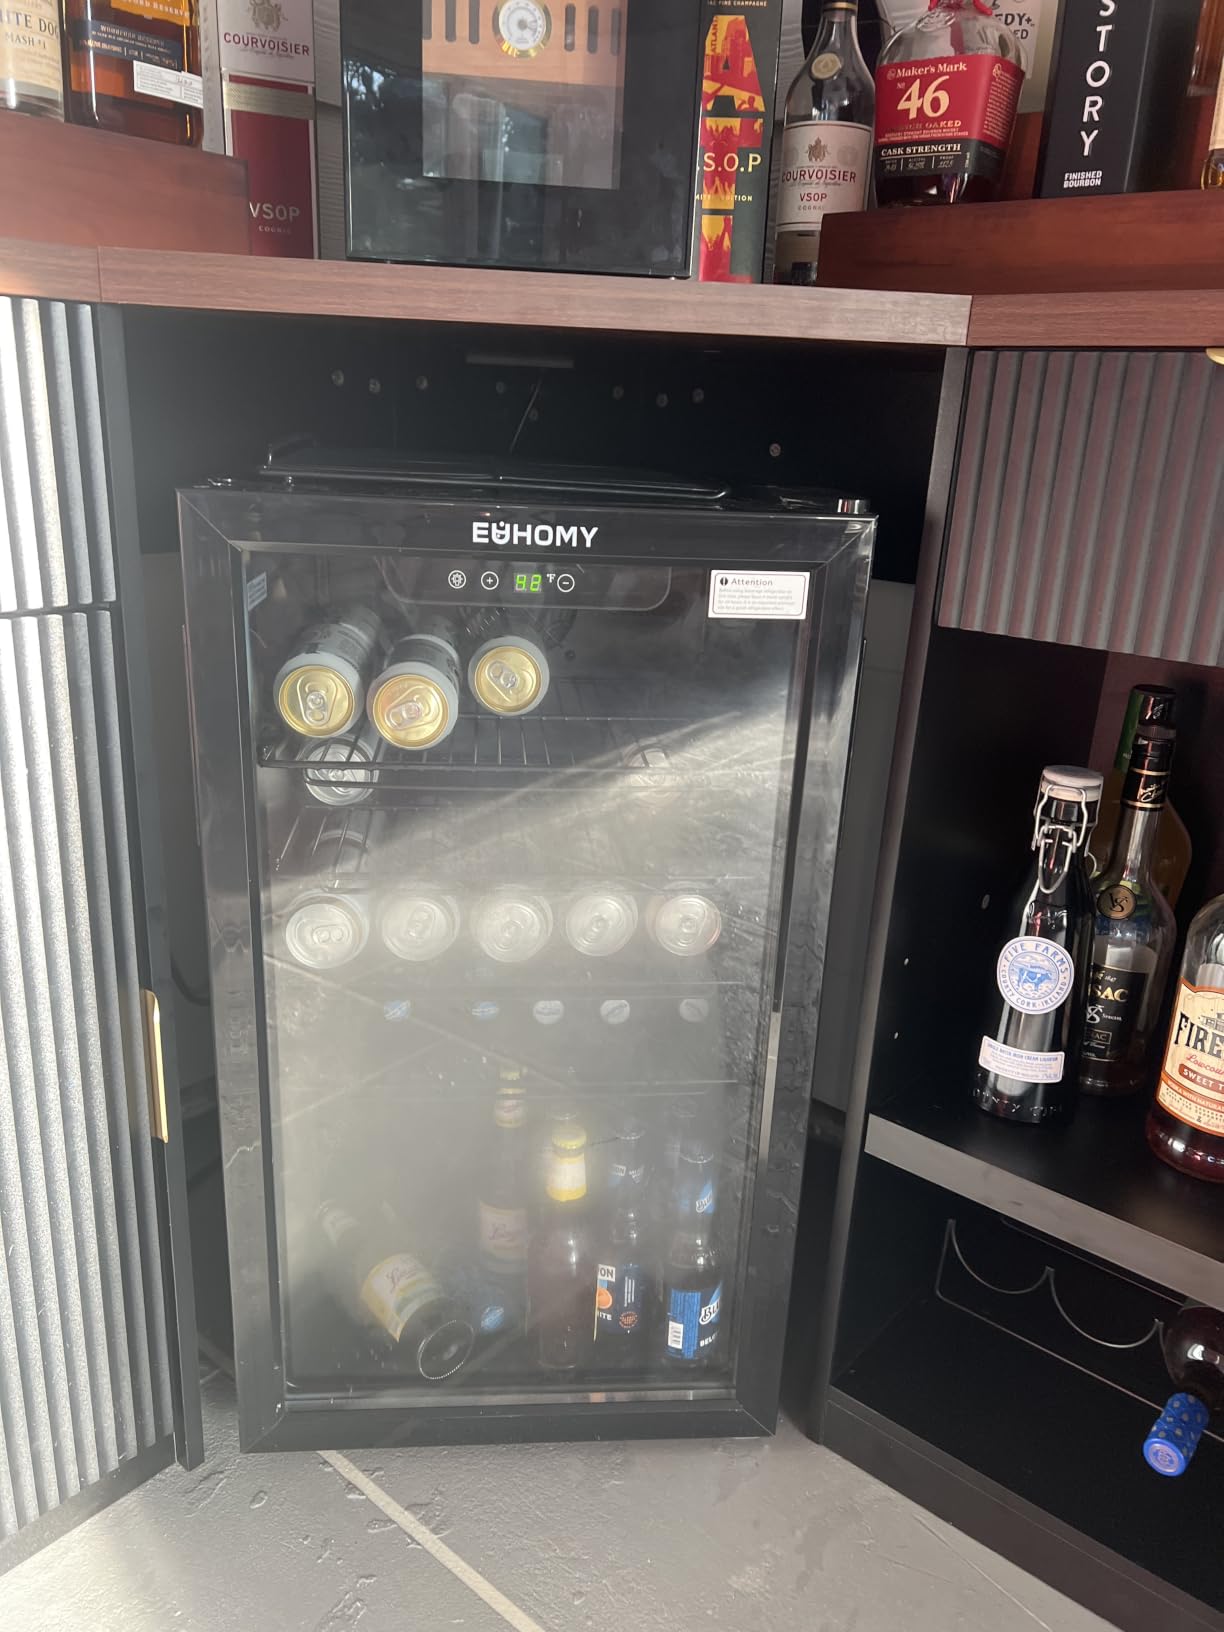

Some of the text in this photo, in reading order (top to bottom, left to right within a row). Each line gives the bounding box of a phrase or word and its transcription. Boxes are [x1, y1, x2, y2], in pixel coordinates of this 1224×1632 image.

[223, 32, 310, 56] COURVOISIER
[896, 62, 967, 78] Maker's Mark
[896, 75, 950, 120] 46
[881, 143, 961, 156] CASK STRENGTH
[1063, 178, 1102, 189] BOURBON
[1064, 170, 1103, 181] FINISHED
[799, 192, 828, 202] VSOP
[249, 201, 300, 222] VSOP
[730, 577, 774, 587] Attention
[1004, 942, 1069, 974] FIVE FARMS
[1001, 969, 1067, 1008] COUNTY CORK IRELAND
[1183, 1068, 1214, 1088] SWEET
